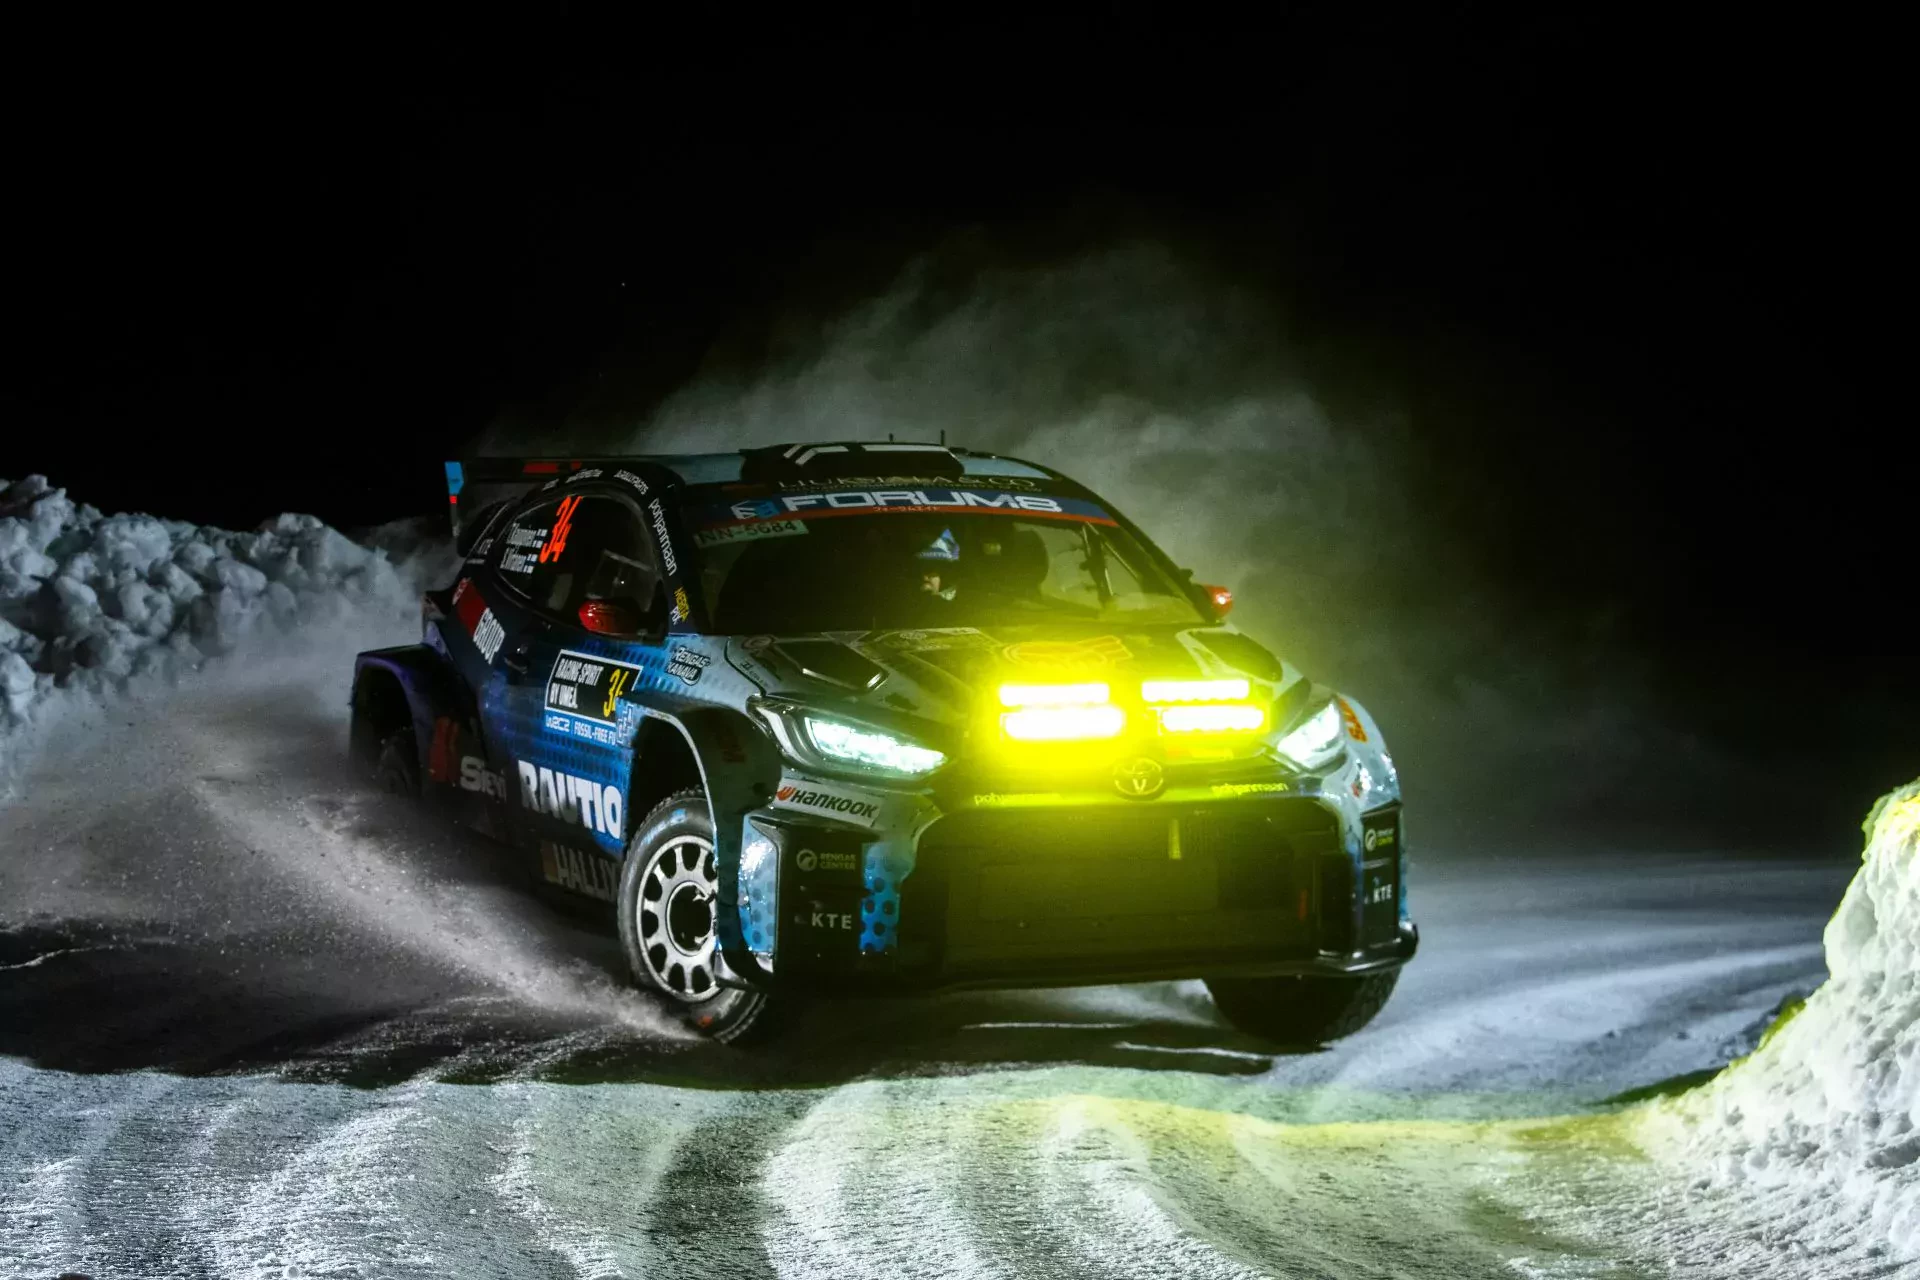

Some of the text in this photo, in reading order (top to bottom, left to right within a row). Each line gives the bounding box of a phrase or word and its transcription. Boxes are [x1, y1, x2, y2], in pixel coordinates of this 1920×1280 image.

[539, 496, 583, 563] 34
[781, 491, 1063, 512] FORUM8
[648, 498, 677, 576] pohjanmaan
[518, 759, 622, 839] RAUTIO
[811, 912, 853, 930] KTE
